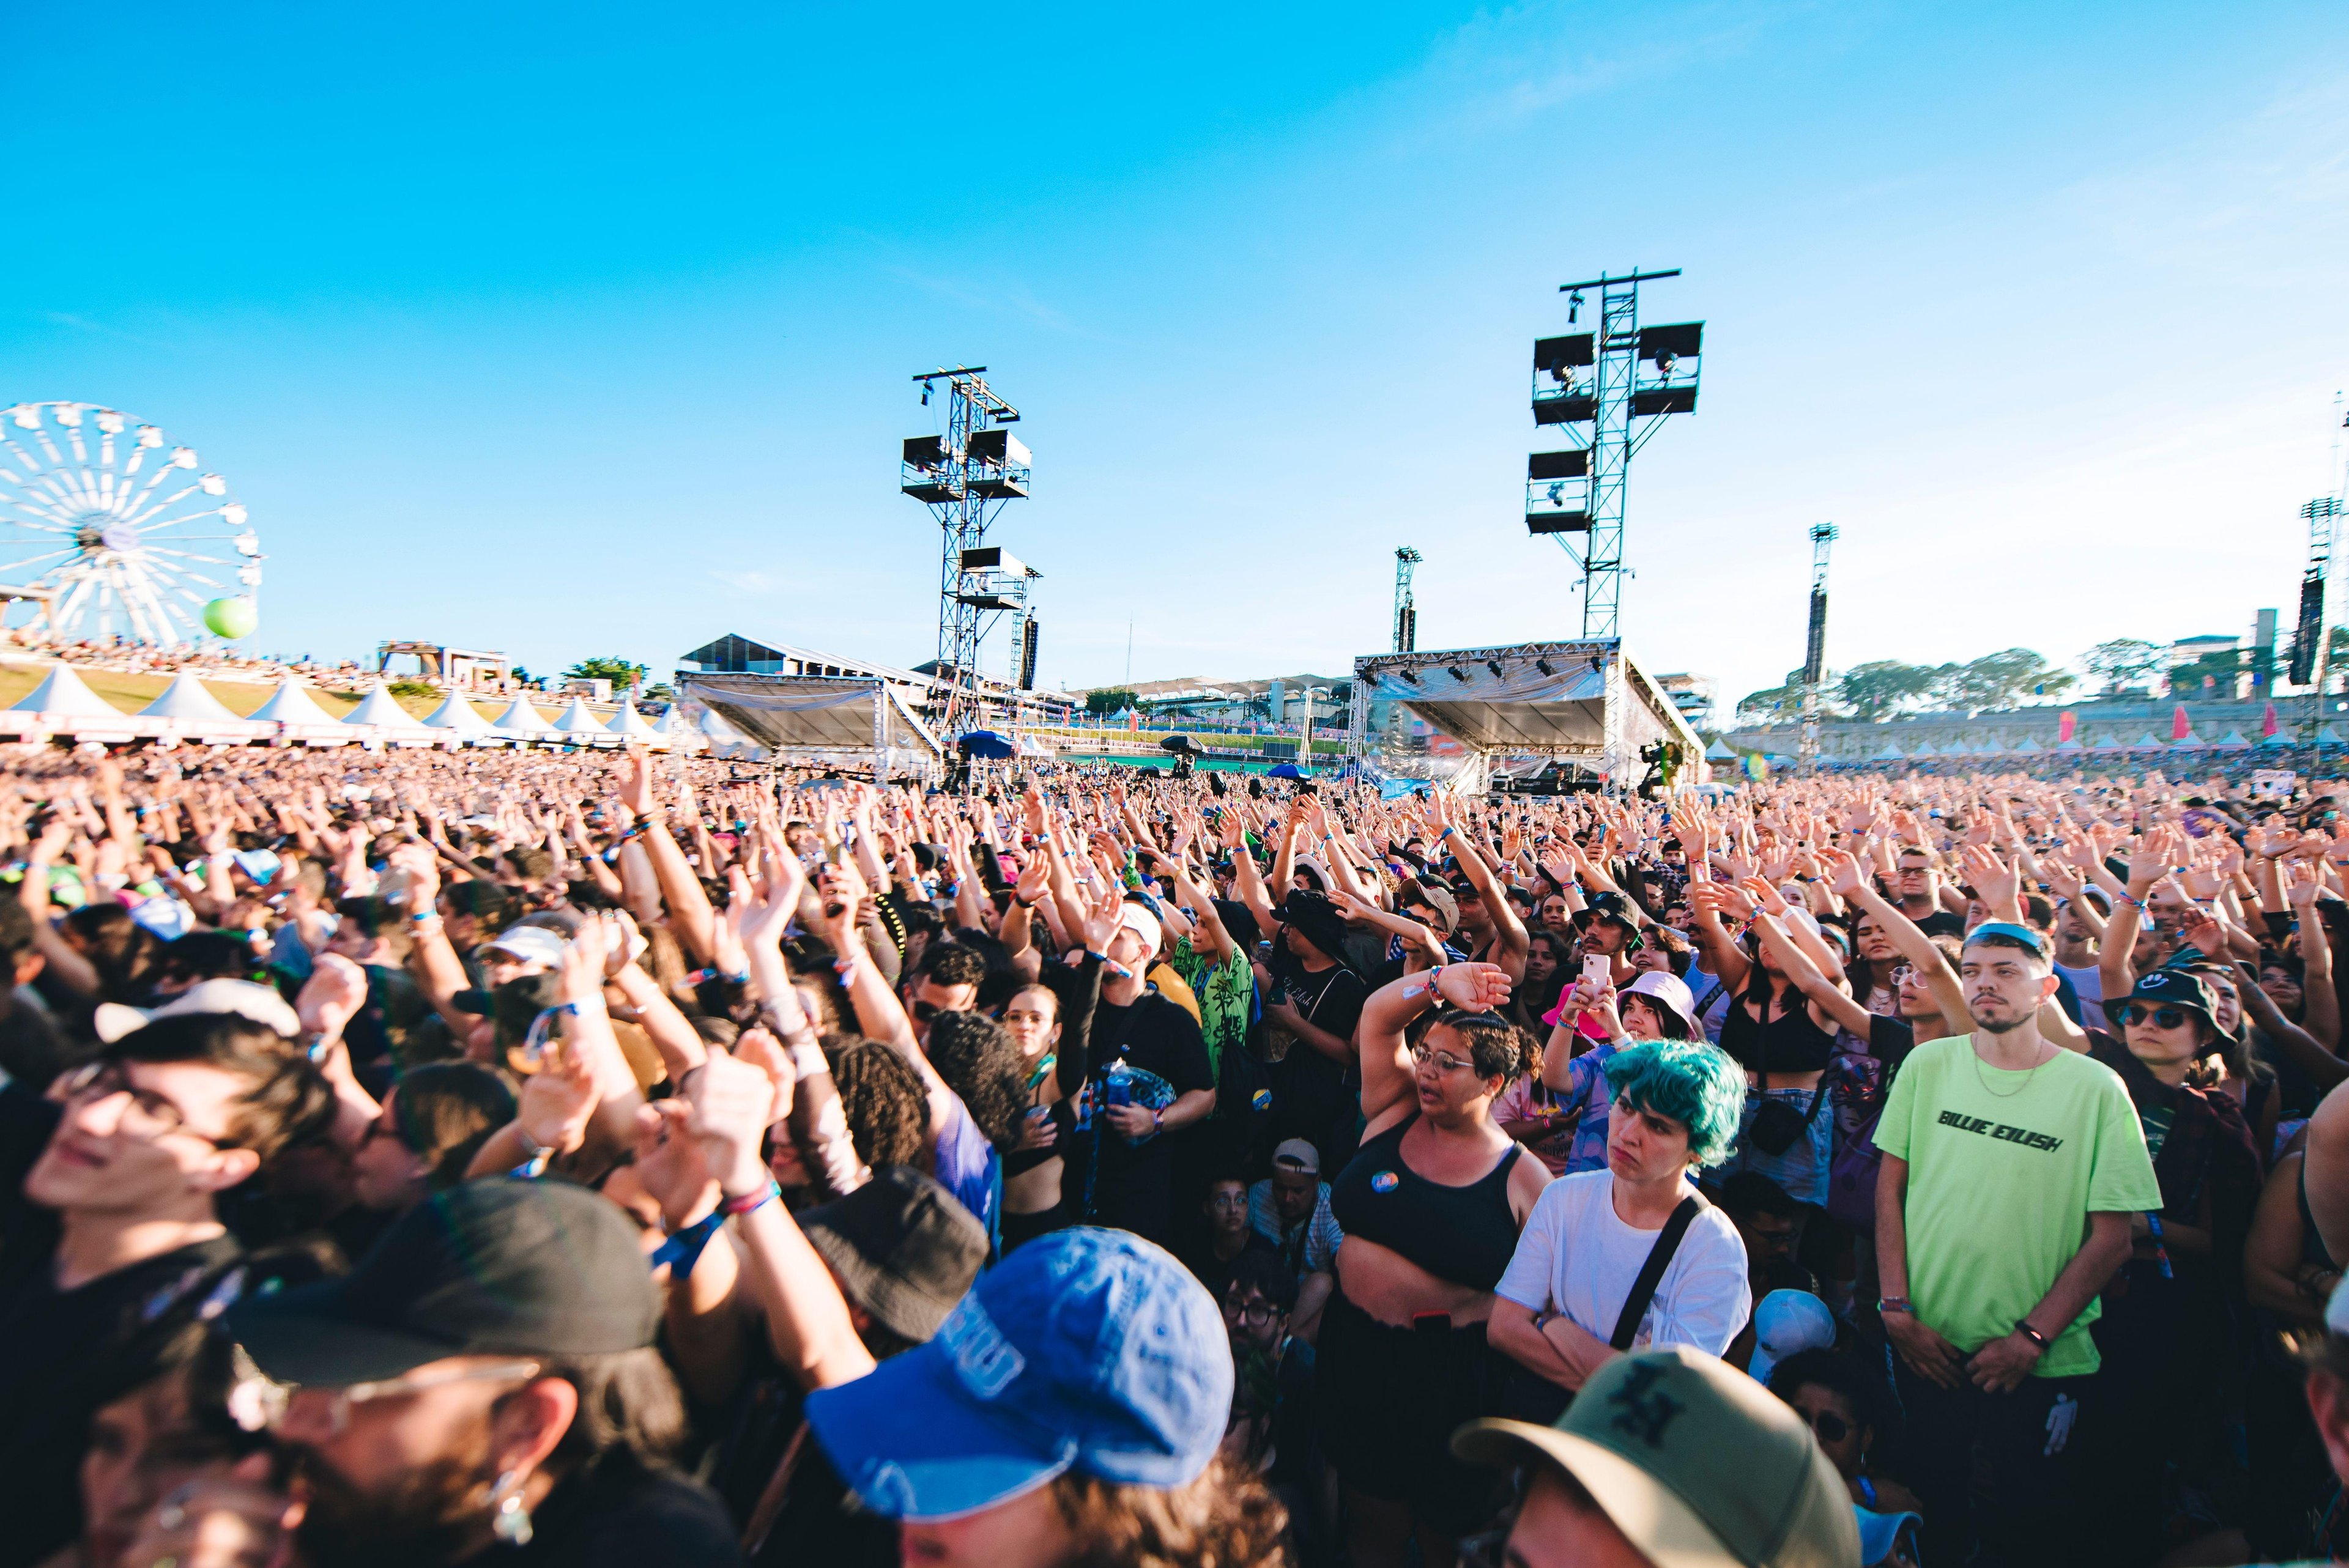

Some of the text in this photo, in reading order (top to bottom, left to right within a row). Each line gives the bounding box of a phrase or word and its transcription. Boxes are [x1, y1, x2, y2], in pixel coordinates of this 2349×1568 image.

[1290, 987, 1313, 1007] Eilish
[1937, 1110, 2064, 1153] BILLIE EILISH
